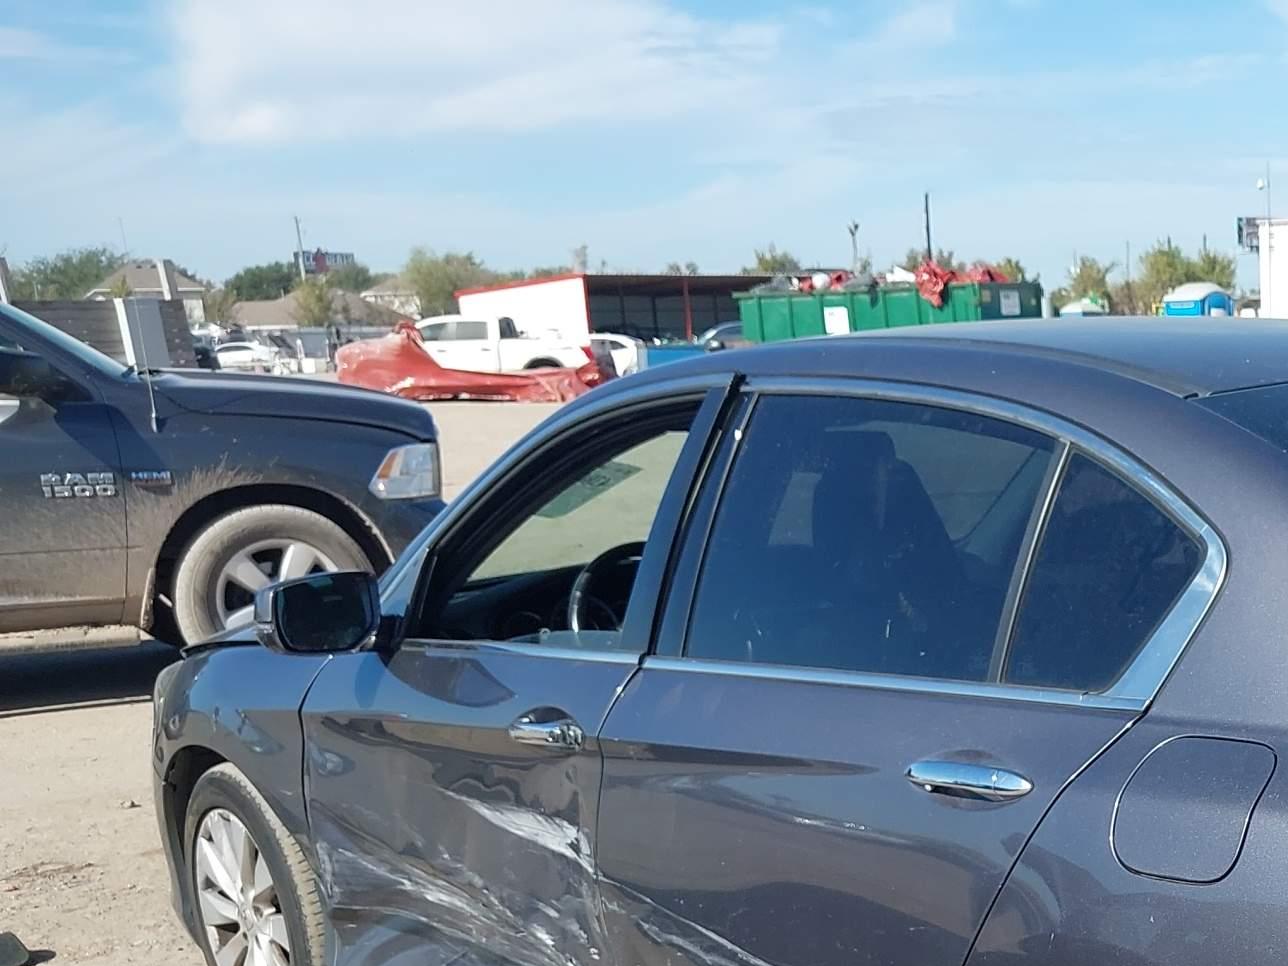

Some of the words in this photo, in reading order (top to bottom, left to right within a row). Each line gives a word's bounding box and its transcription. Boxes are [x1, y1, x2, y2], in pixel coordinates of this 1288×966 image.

[40, 472, 115, 485] RAM
[130, 471, 172, 481] HEMI
[42, 484, 117, 498] 1500
